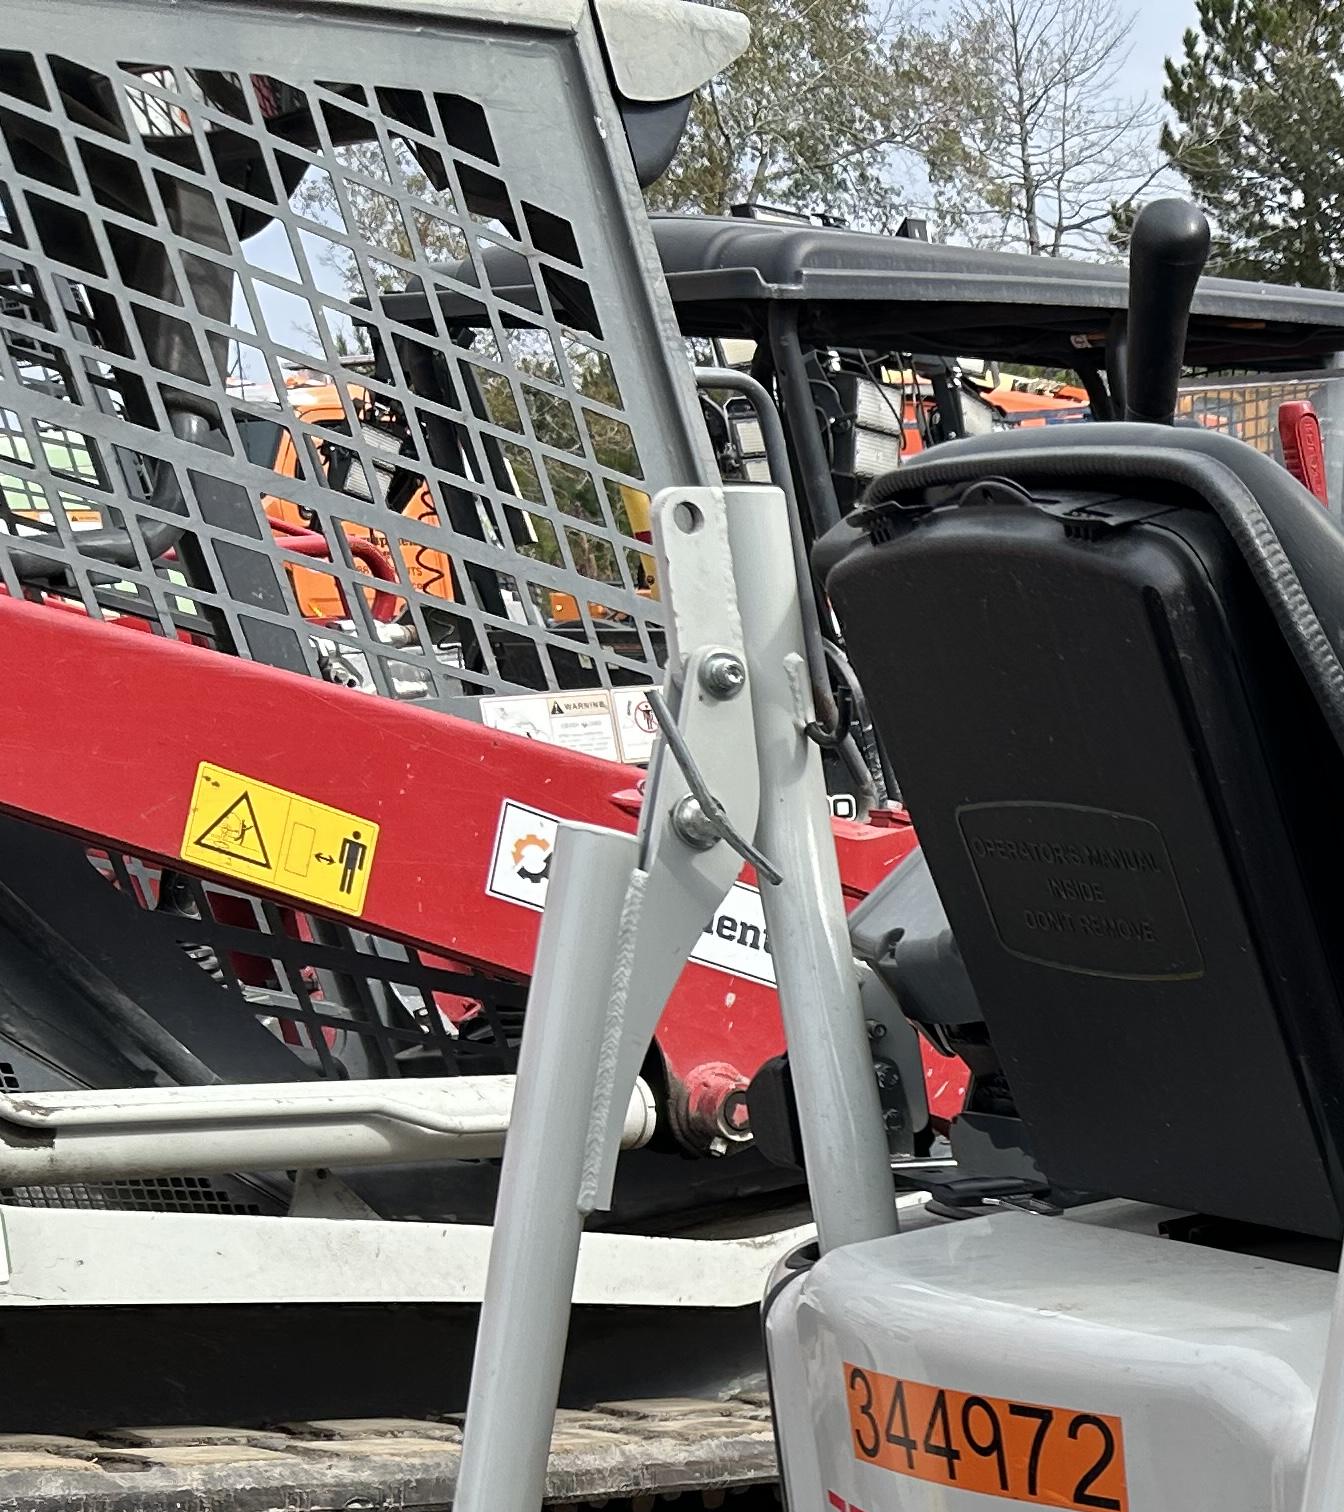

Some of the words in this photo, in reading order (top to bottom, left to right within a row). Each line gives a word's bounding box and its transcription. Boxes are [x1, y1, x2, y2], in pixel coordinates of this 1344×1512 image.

[1084, 848, 1161, 873] MANUAL
[1048, 879, 1106, 903] INSIDE
[1080, 914, 1157, 942] REMOVE
[849, 1367, 1122, 1512] 344972
